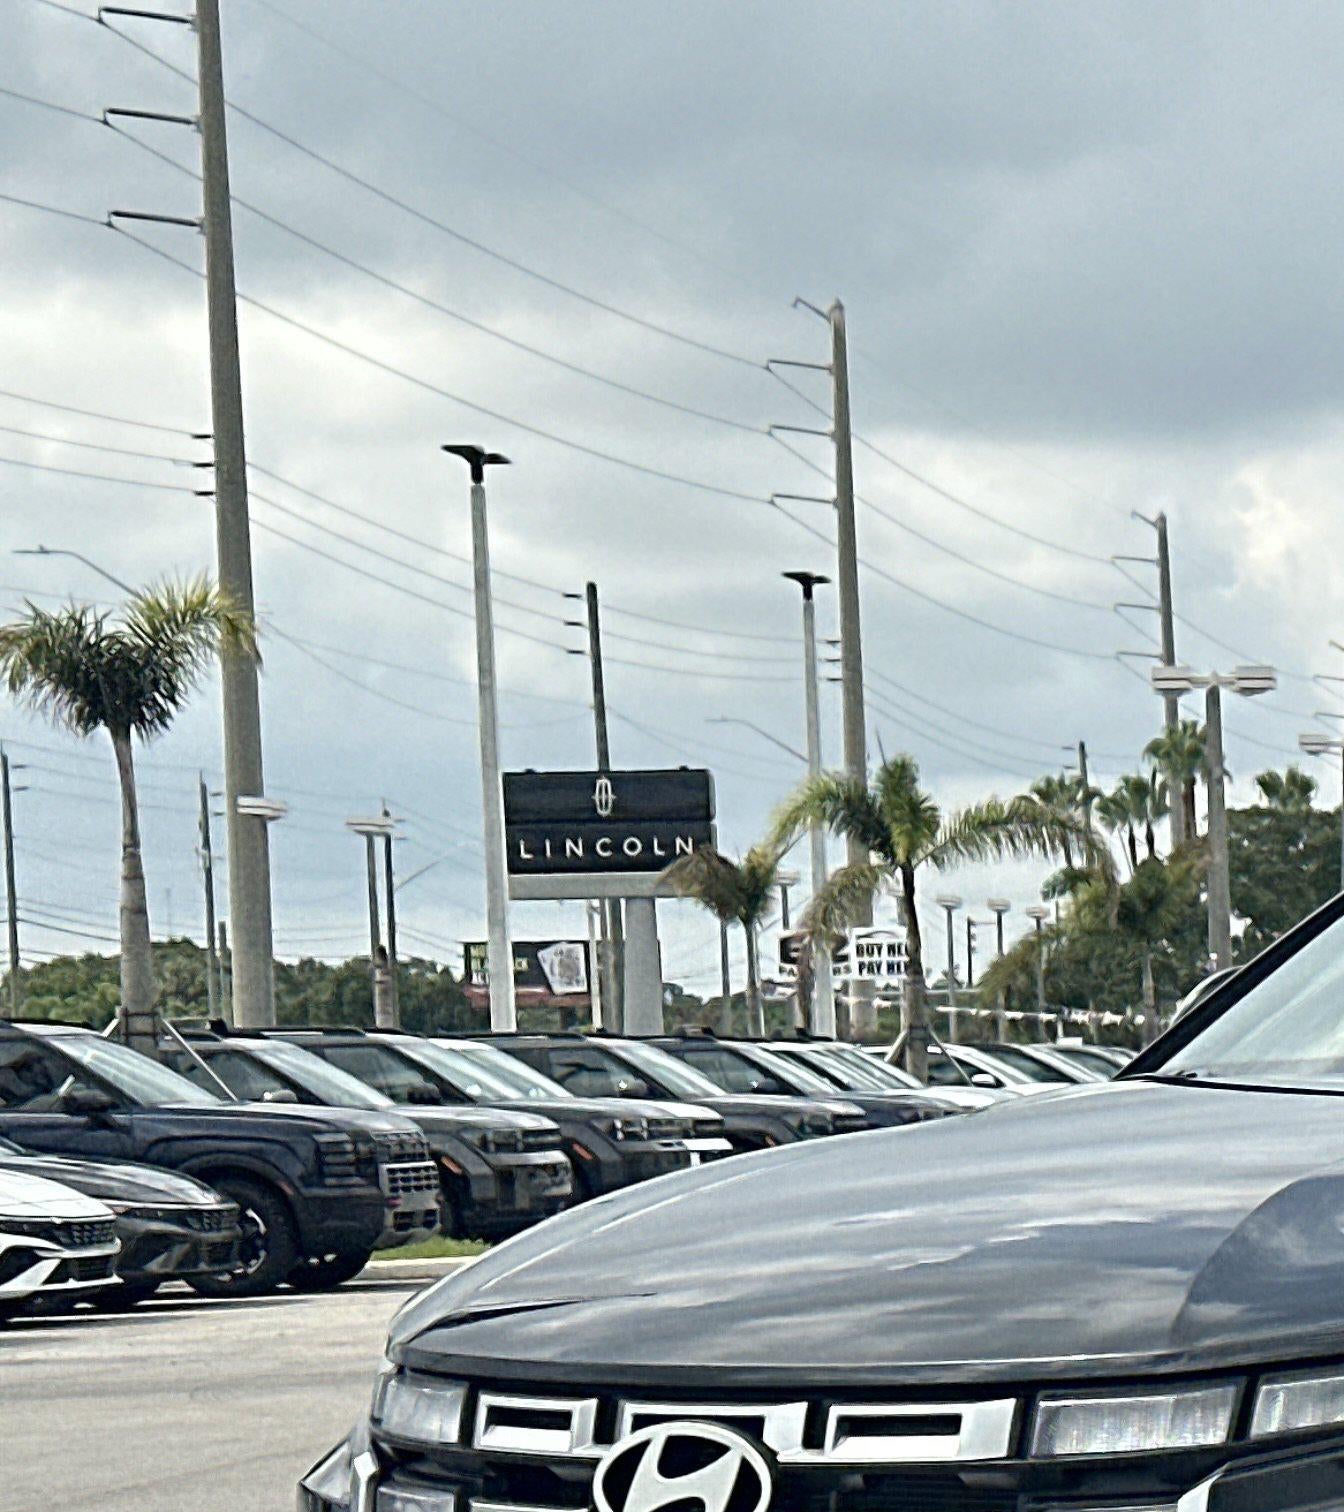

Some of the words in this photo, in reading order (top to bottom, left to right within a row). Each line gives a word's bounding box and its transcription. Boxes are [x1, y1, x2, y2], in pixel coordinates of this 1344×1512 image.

[519, 835, 693, 859] LINCOLN
[856, 943, 883, 958] BUY
[858, 960, 883, 976] PAY
